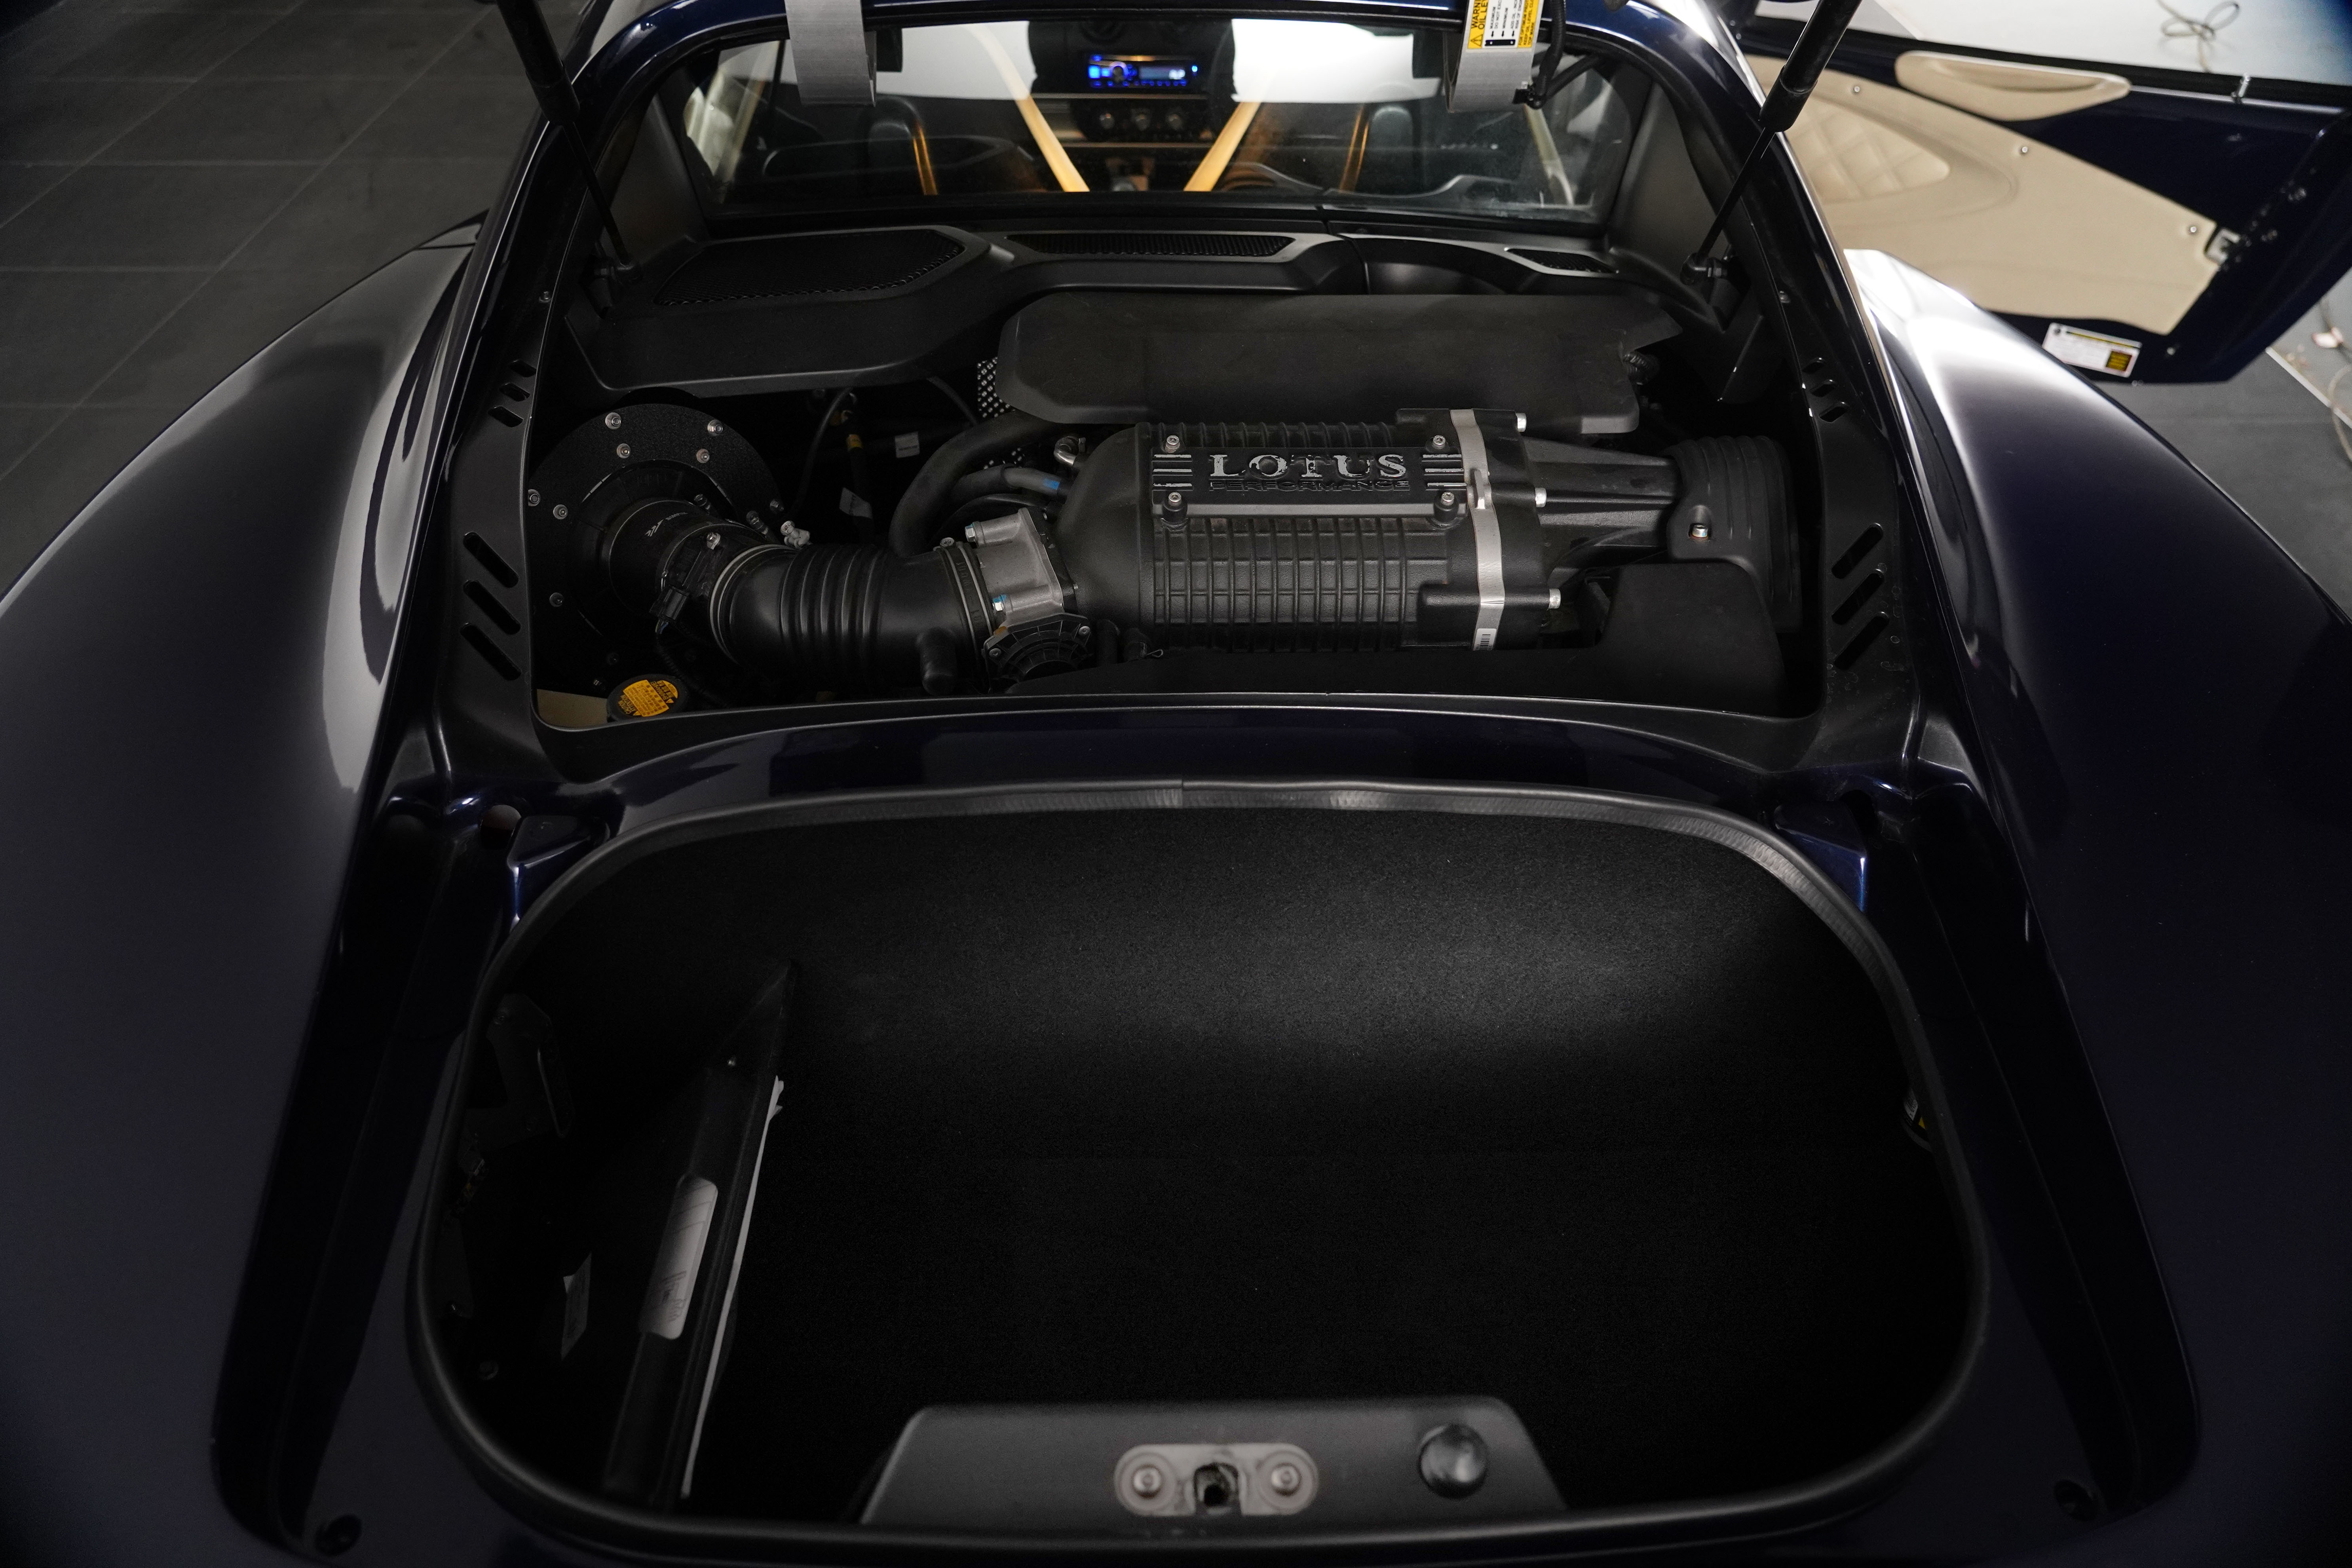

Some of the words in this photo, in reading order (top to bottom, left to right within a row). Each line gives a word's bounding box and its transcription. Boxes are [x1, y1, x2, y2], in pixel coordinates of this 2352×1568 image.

[1208, 454, 1407, 479] LOTUS
[1209, 481, 1411, 492] PERFORMANCE
[617, 700, 631, 714] CAUTION
